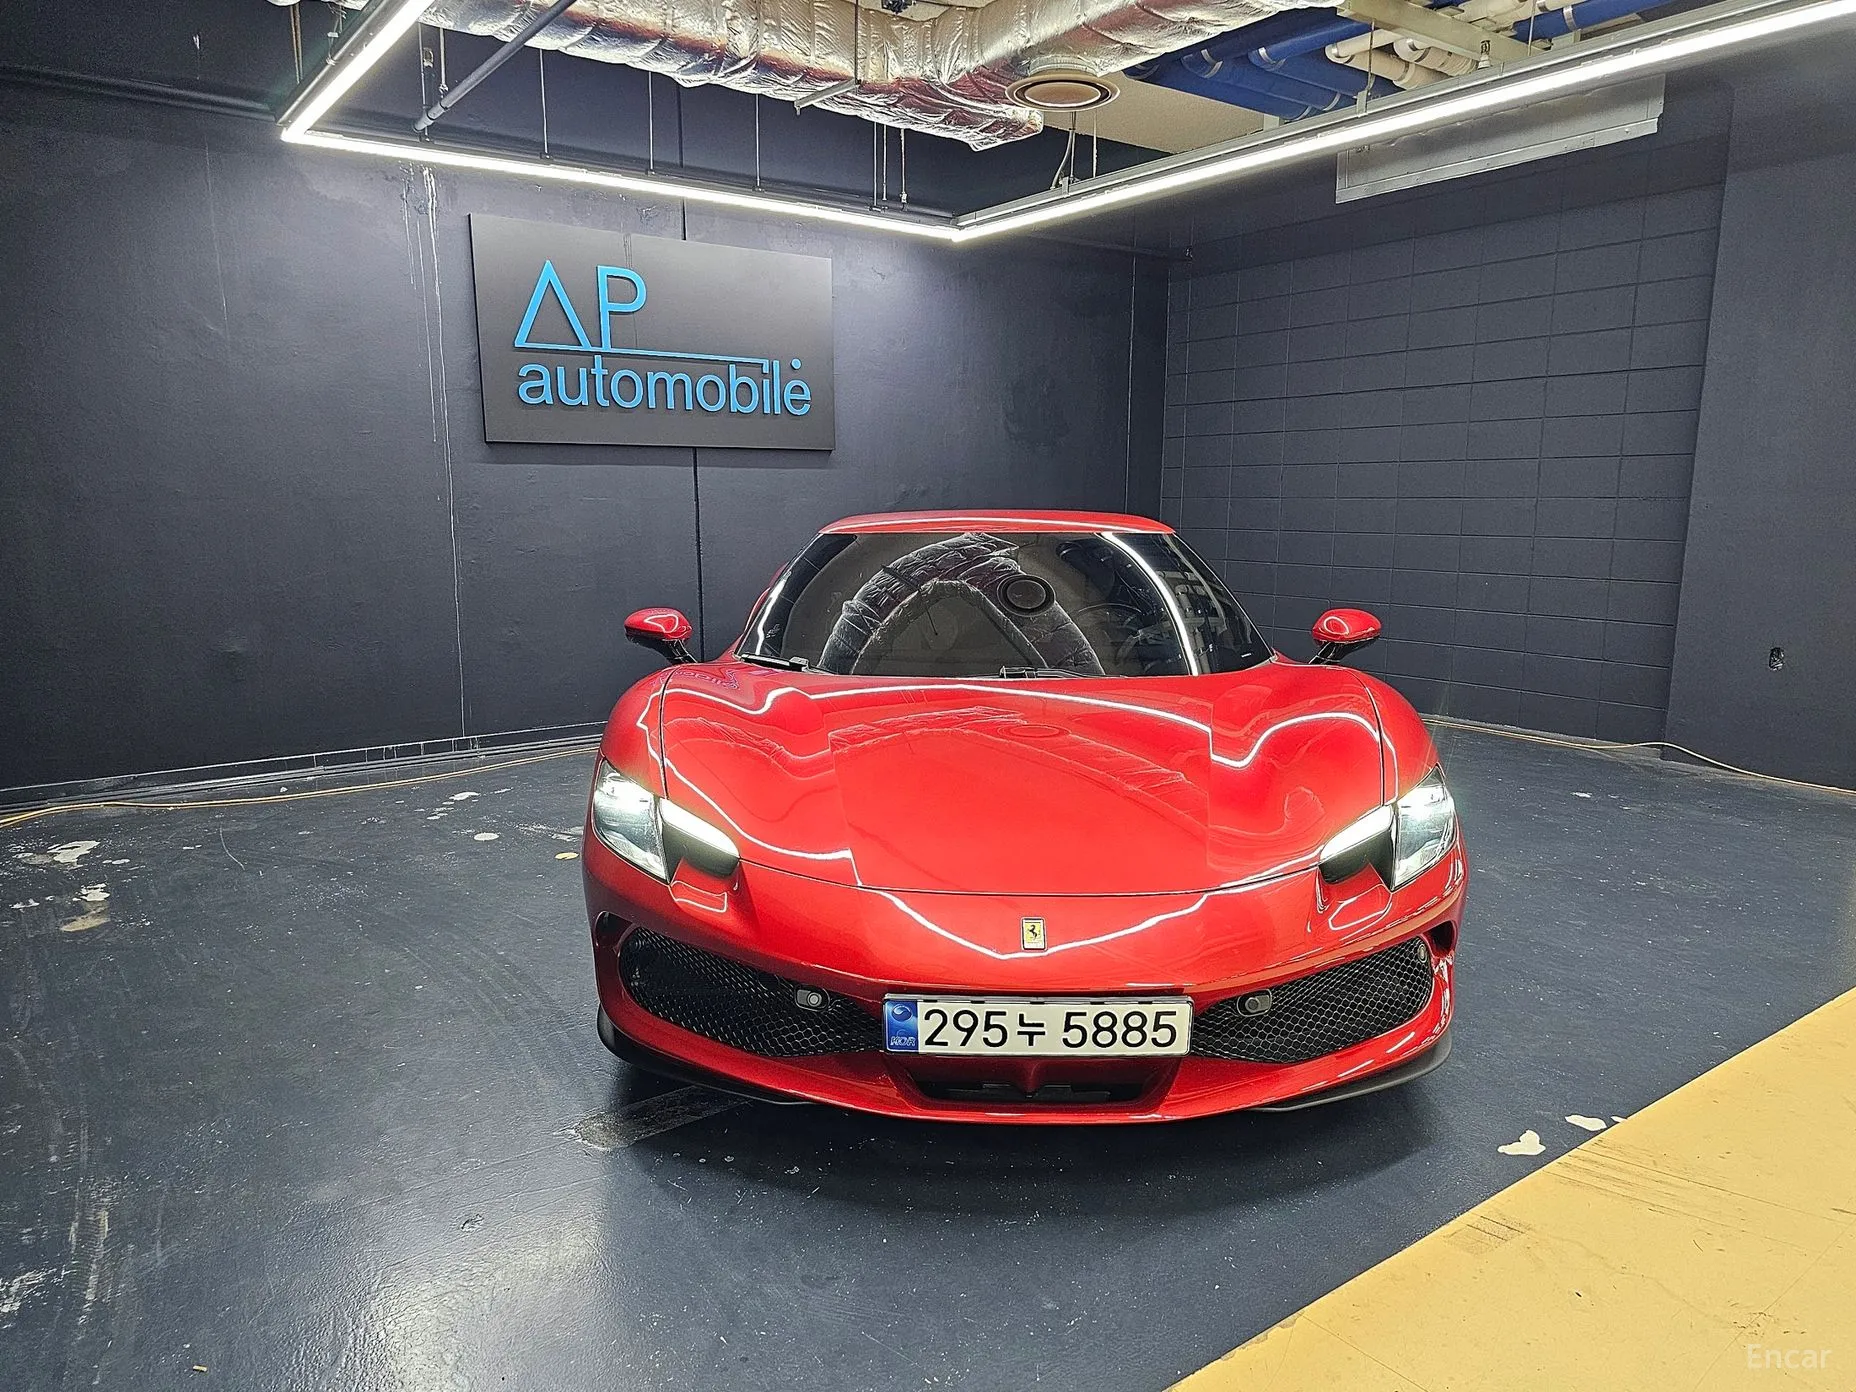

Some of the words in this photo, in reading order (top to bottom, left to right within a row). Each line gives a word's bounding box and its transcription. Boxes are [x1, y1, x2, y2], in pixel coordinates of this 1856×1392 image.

[514, 260, 647, 351] AP
[517, 354, 812, 416] automobile
[923, 1008, 1046, 1048] 295누
[1062, 1010, 1177, 1049] 5885
